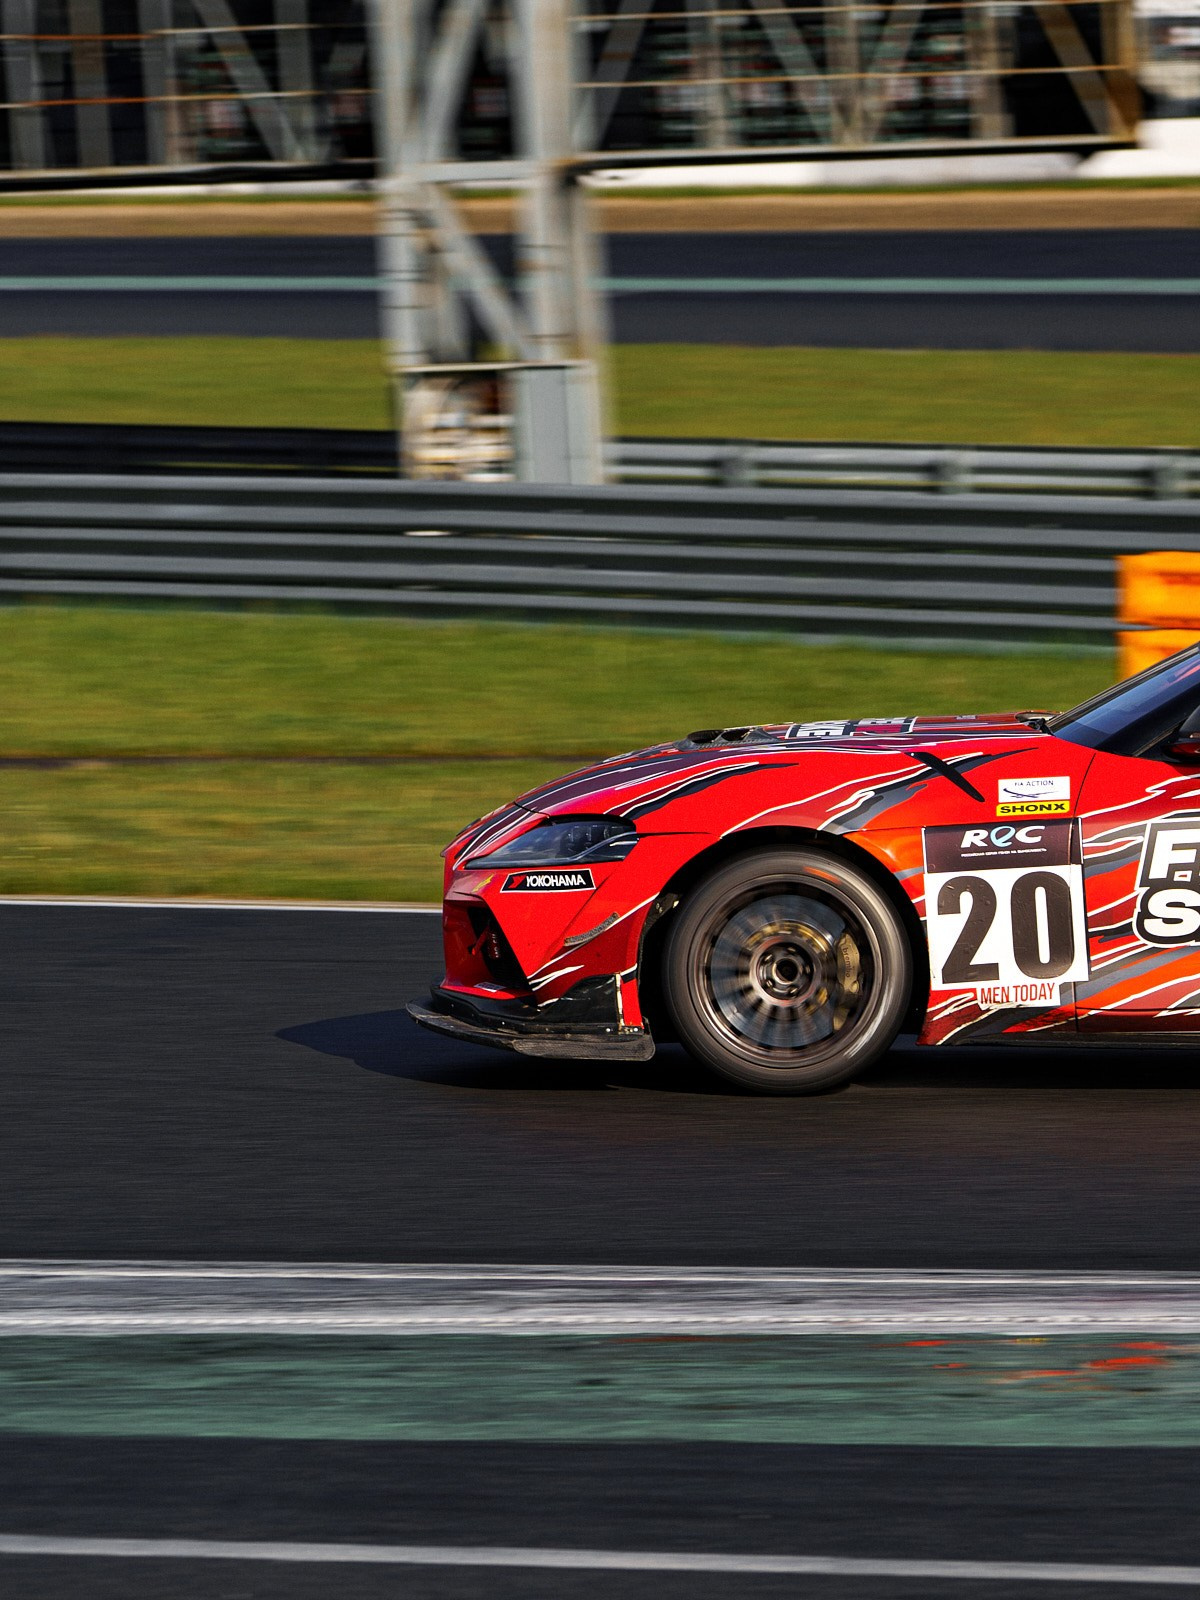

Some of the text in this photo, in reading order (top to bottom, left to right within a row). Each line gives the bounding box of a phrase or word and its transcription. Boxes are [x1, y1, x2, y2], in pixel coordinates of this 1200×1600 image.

[1000, 803, 1066, 814] SHONX
[526, 874, 587, 888] YOKOHAMA
[937, 870, 1075, 985] 20
[980, 982, 1056, 1004] MEN TODAY
